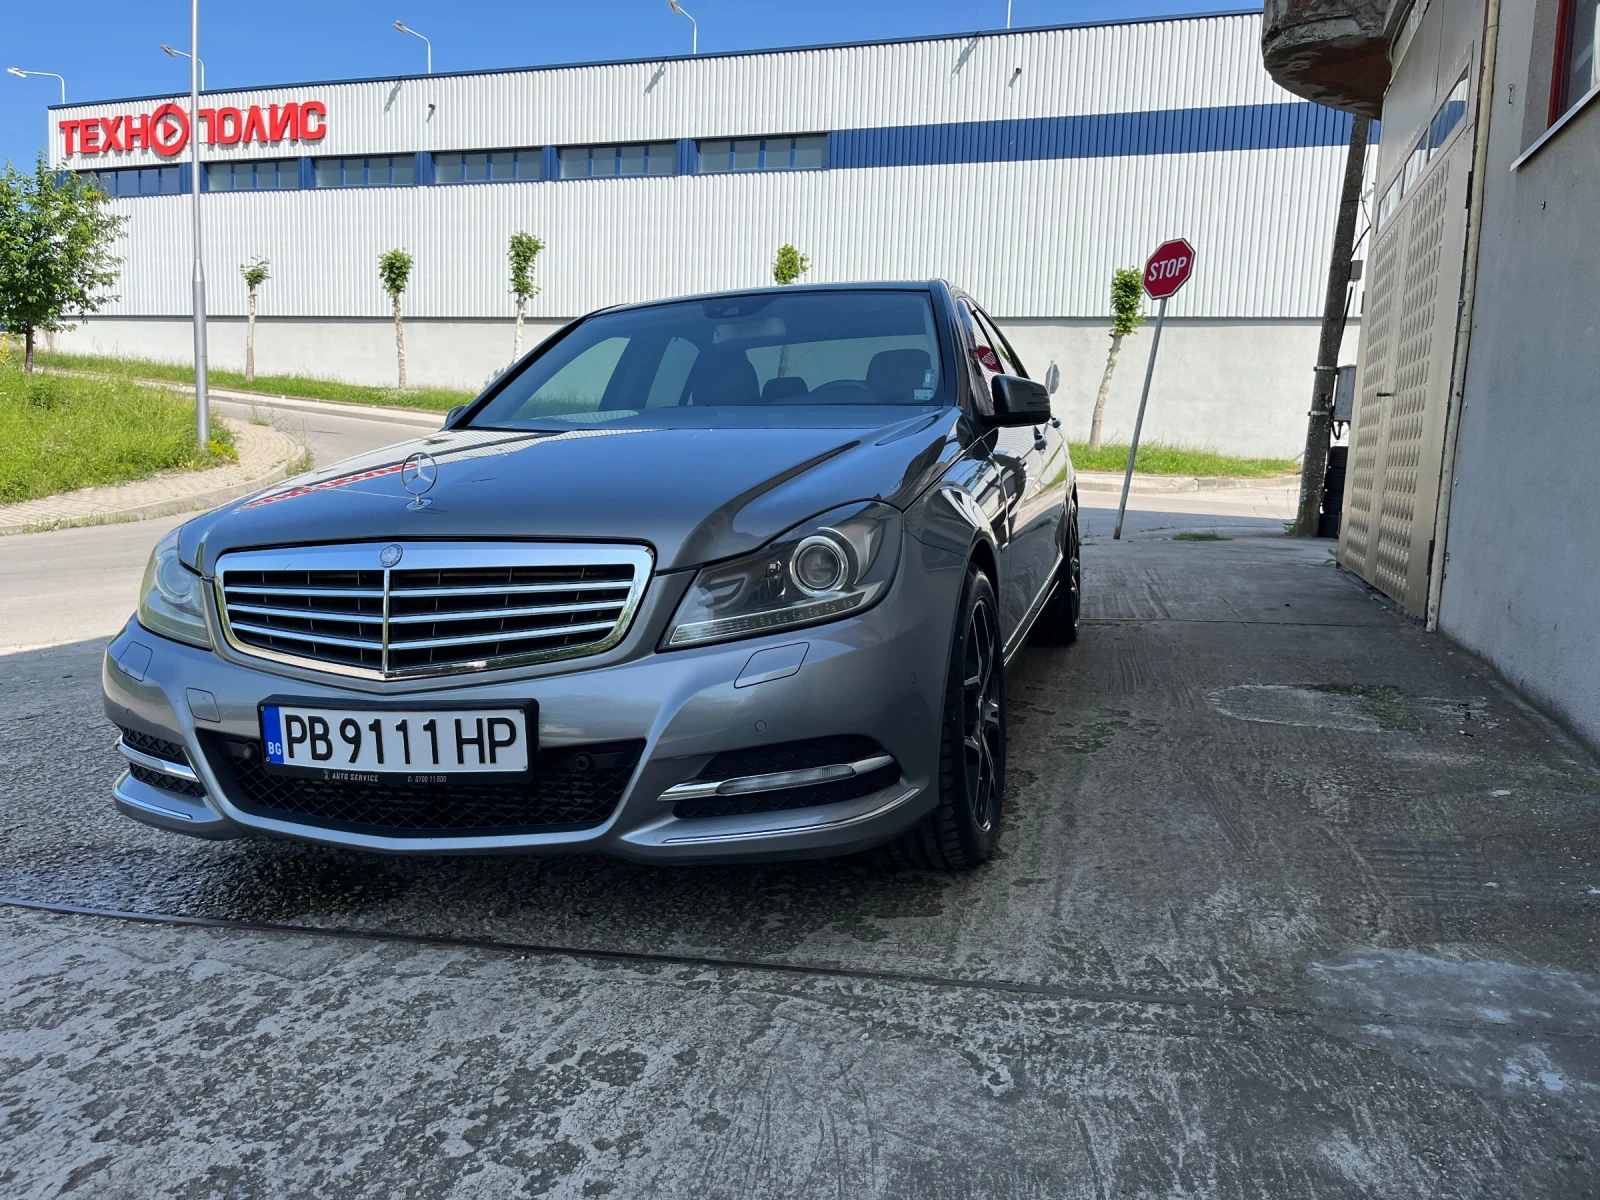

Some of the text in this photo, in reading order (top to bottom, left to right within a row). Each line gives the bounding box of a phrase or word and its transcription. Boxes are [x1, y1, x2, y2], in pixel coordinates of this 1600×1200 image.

[1148, 256, 1187, 281] STOP
[268, 741, 282, 756] BG
[332, 772, 379, 782] AUTO SERVICE
